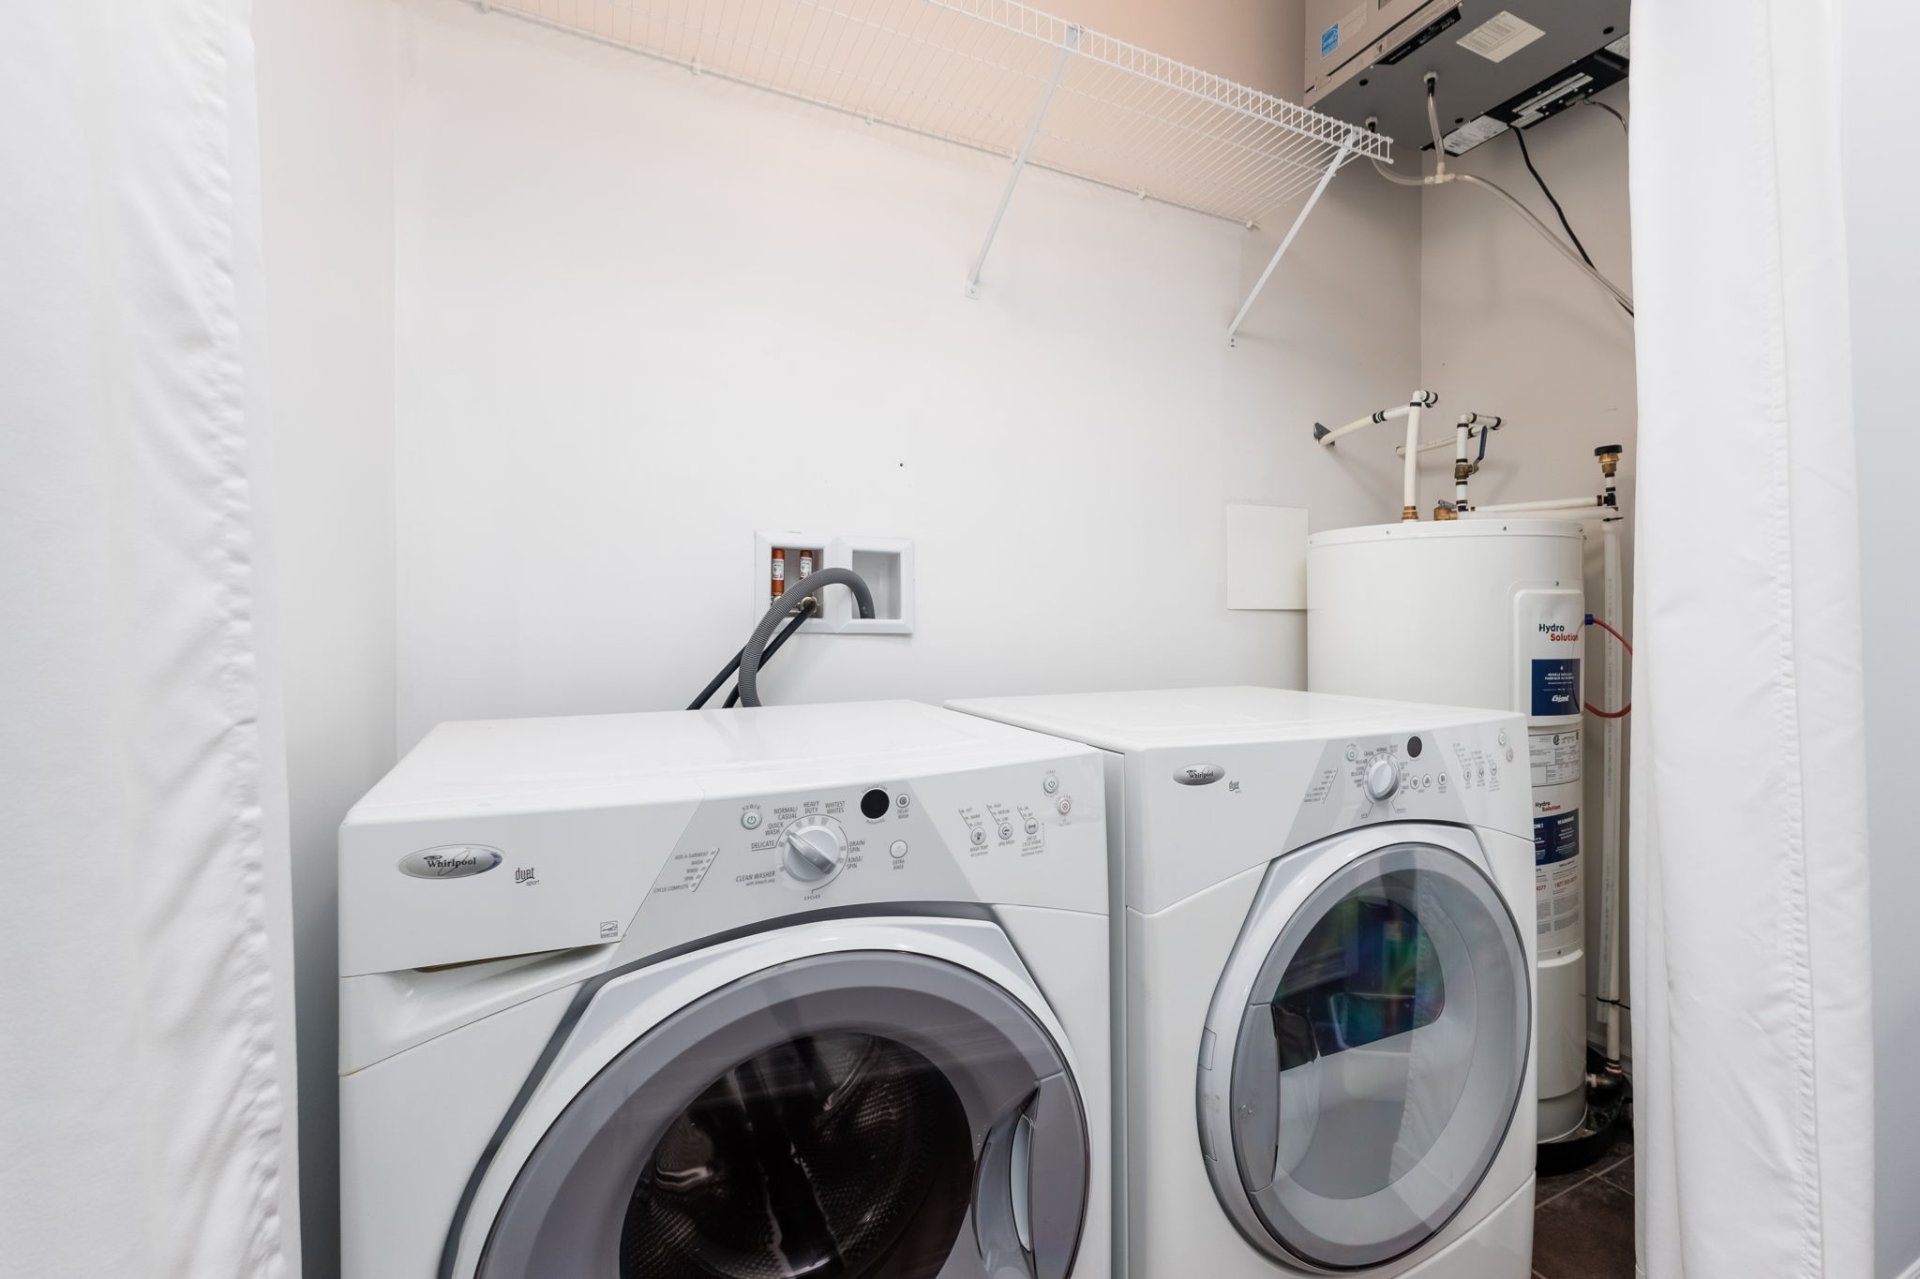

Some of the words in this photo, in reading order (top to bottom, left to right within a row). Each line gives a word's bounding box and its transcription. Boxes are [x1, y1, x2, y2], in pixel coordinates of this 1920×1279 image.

[1538, 623, 1565, 634] Hydro
[1549, 633, 1579, 642] Solution
[1188, 770, 1214, 779] Whirlpool
[825, 800, 846, 808] WHITEST
[751, 840, 775, 849] DELICATE
[426, 857, 477, 869] Whirlpool
[514, 867, 534, 881] duet
[735, 874, 753, 882] CLEAN
[754, 871, 776, 879] WASHER
